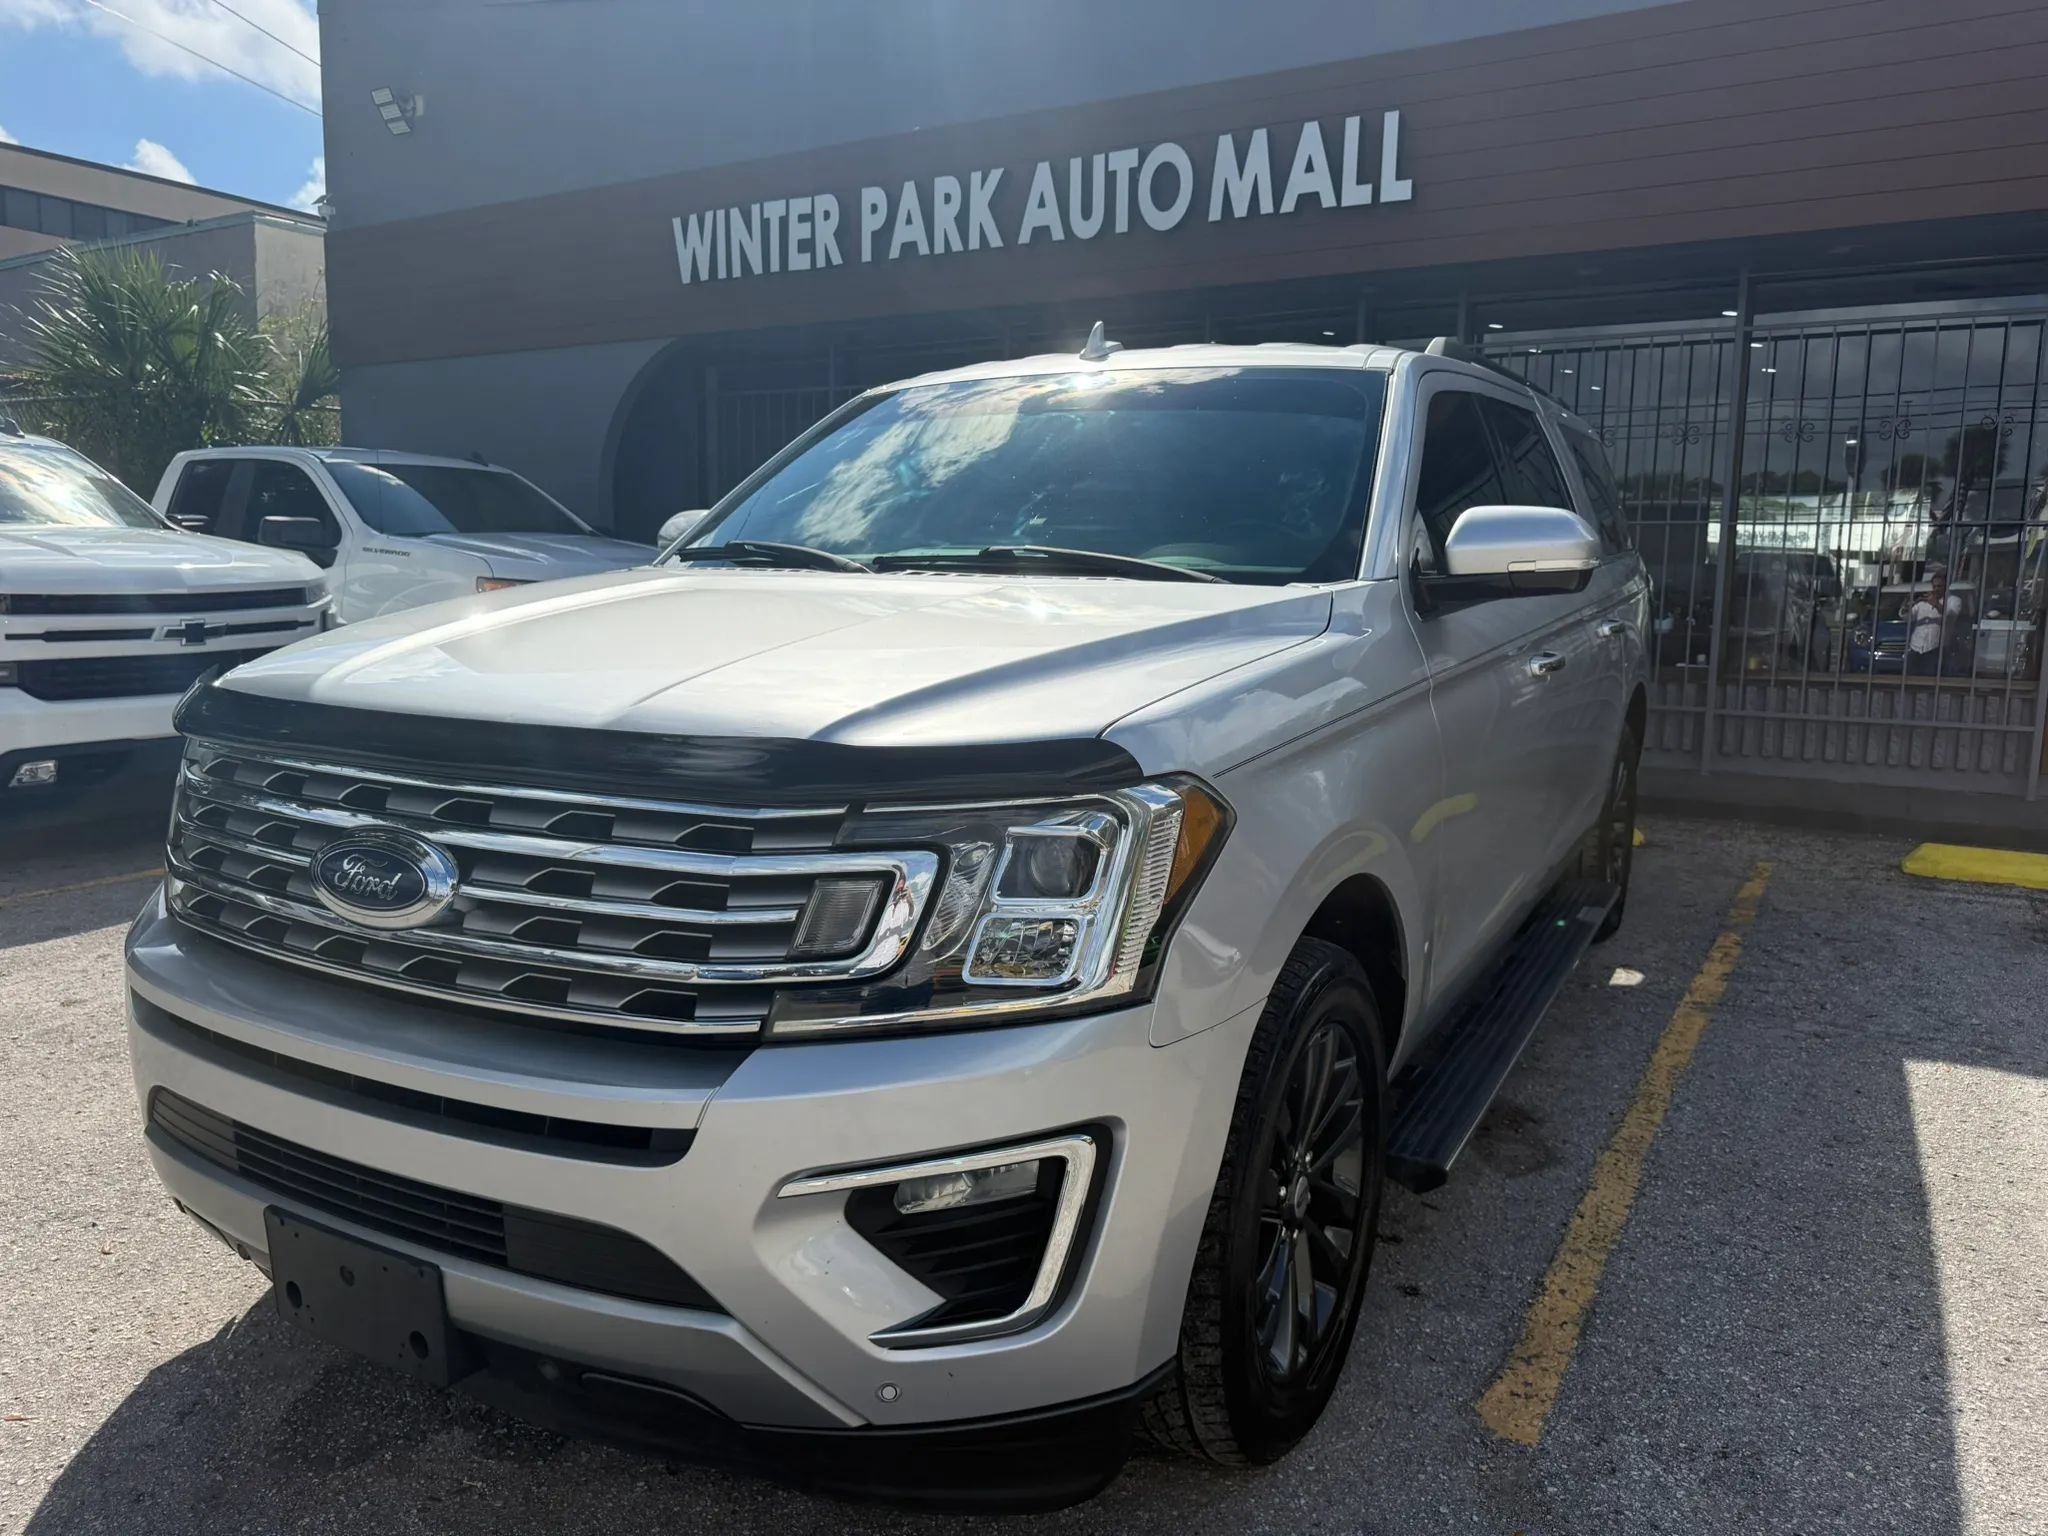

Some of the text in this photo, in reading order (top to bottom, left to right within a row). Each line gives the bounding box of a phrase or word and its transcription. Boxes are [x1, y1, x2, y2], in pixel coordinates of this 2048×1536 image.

[672, 110, 1413, 284] WINTER PARK AUTO MALL
[334, 854, 402, 900] Ford
